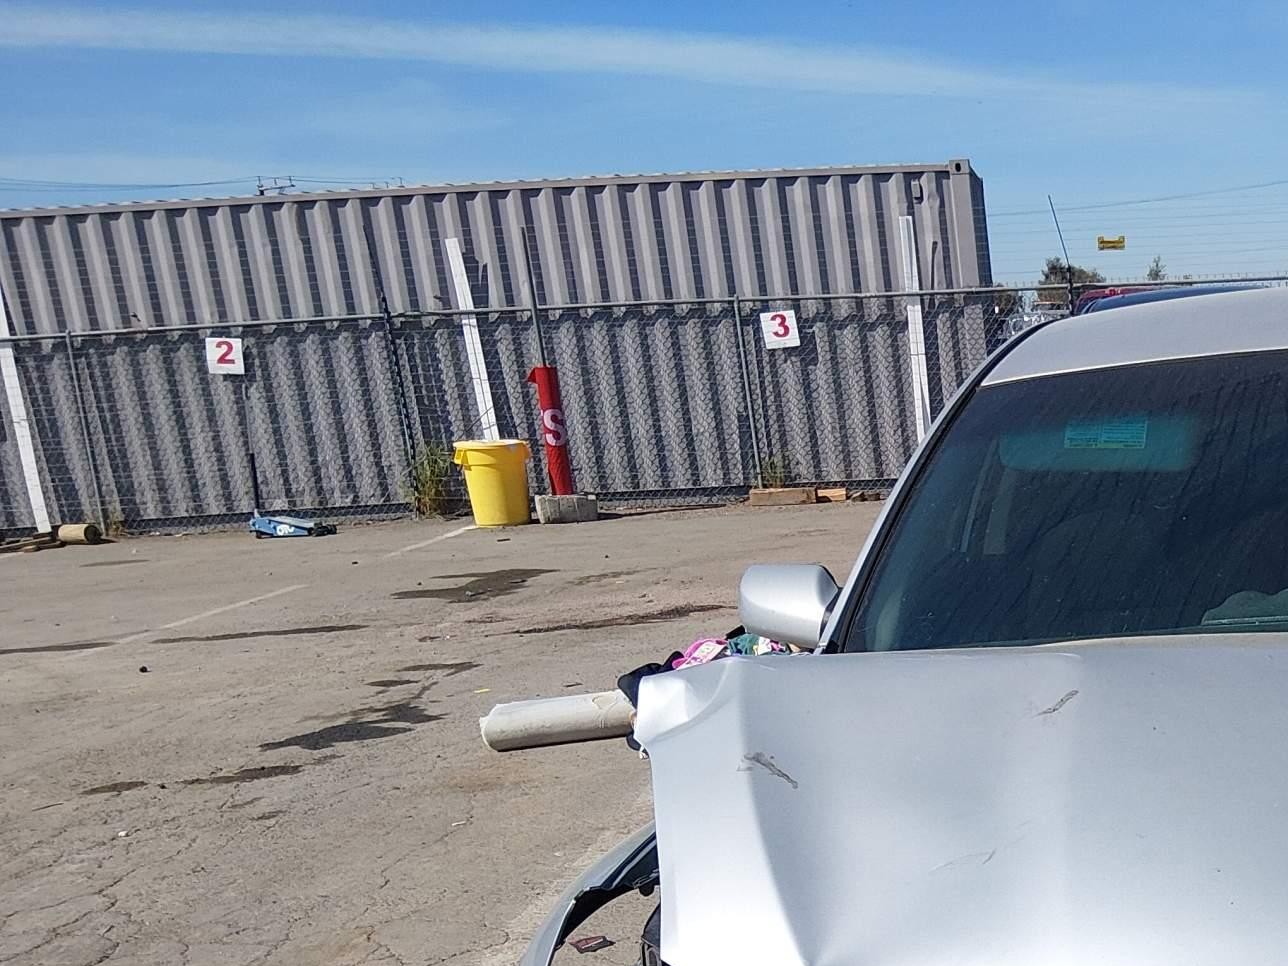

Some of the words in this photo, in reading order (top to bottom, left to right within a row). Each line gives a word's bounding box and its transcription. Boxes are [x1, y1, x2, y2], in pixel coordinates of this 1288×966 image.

[769, 313, 790, 338] 3
[215, 340, 236, 364] 2
[541, 408, 567, 447] S
